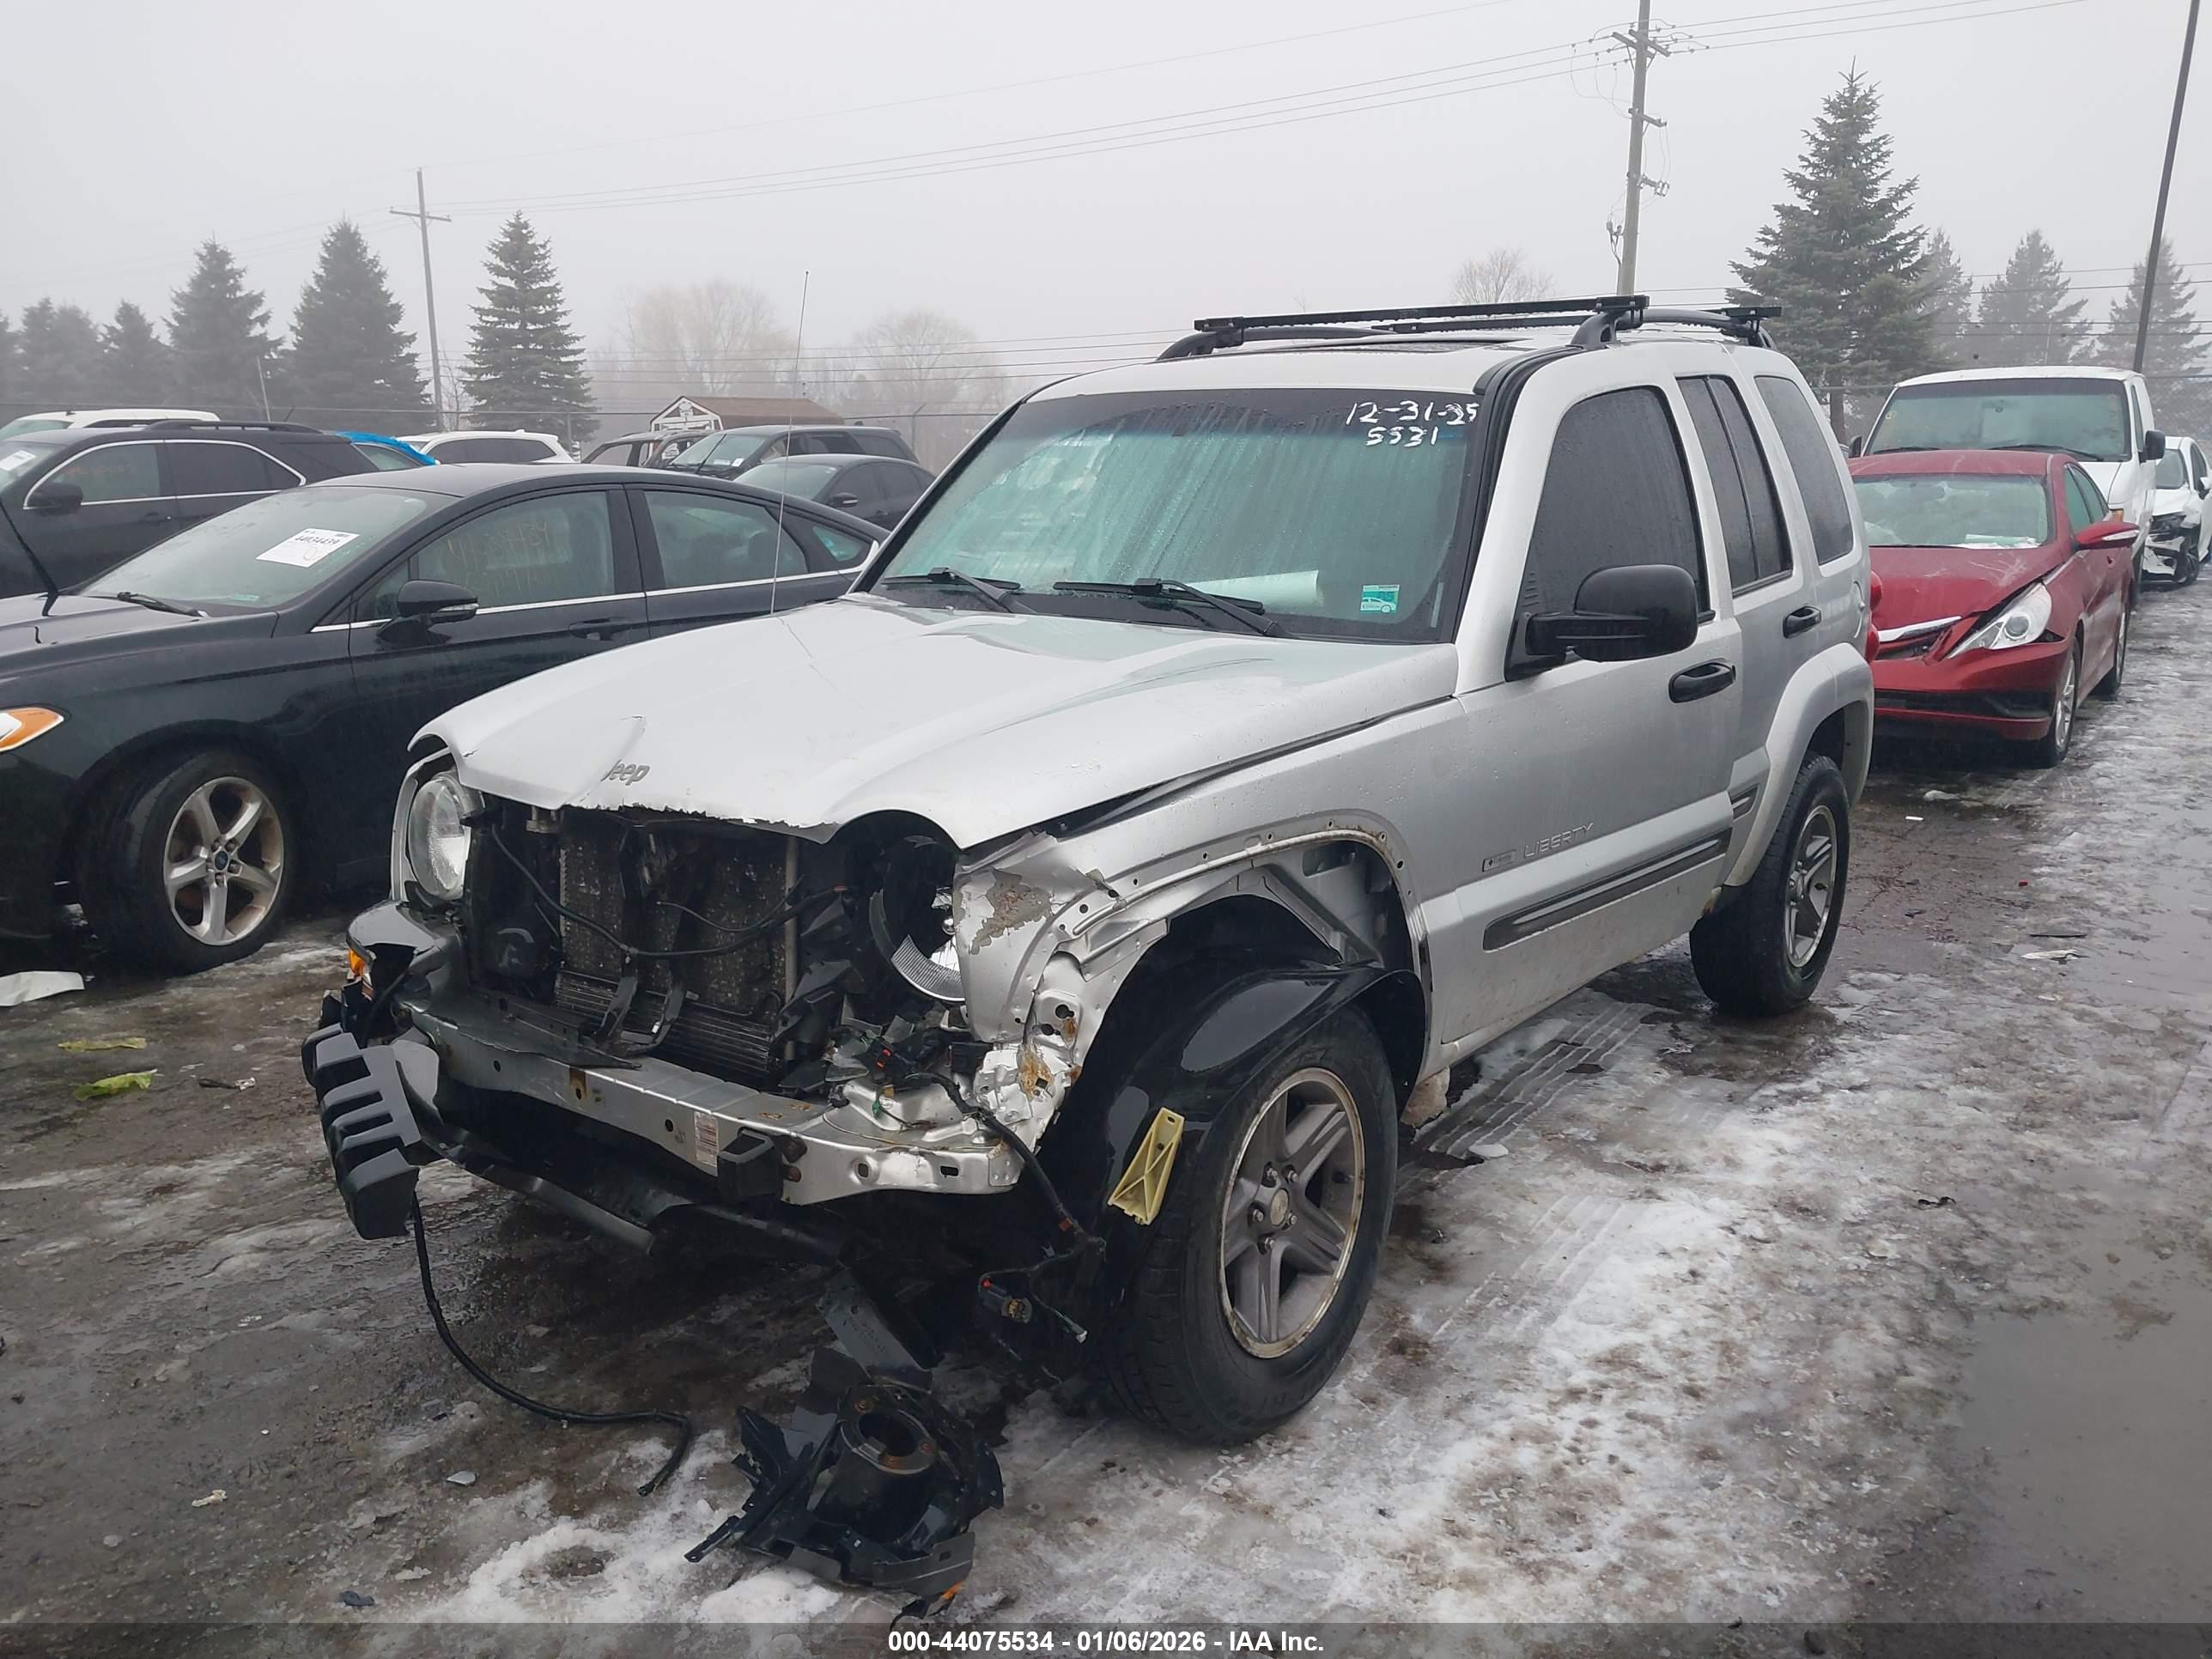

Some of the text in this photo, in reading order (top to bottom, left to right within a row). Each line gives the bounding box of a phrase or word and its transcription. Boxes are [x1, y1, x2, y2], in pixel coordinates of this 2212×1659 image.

[1346, 400, 1480, 426] 12-31-25
[1365, 426, 1438, 447] 5531
[1523, 822, 1594, 859] LIBERTY
